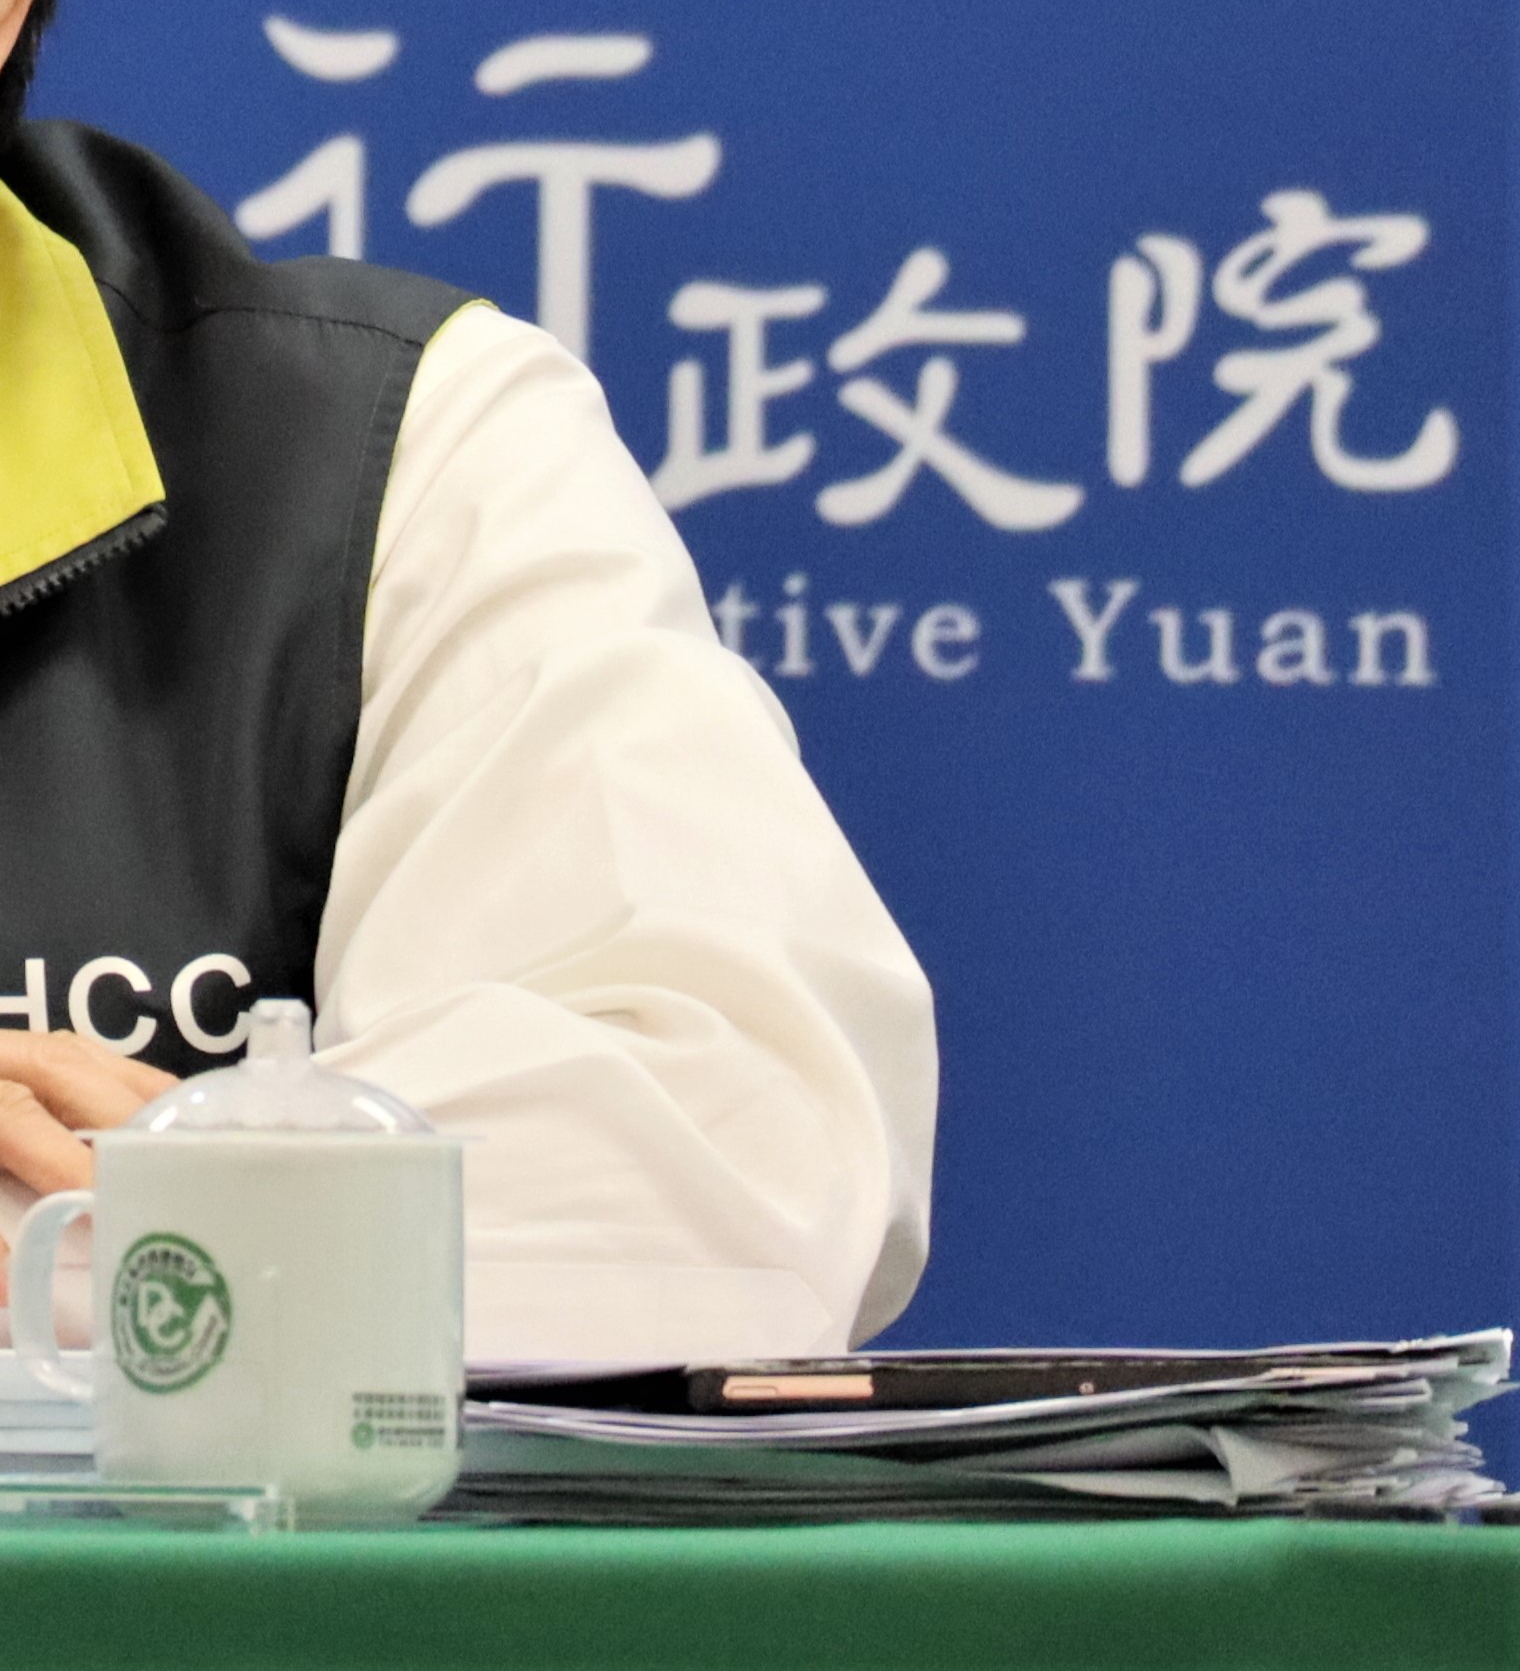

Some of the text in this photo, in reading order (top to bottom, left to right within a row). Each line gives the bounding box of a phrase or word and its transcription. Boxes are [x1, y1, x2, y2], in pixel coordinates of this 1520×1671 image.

[235, 17, 1458, 531] 行政院
[1049, 578, 1438, 685] Yuan
